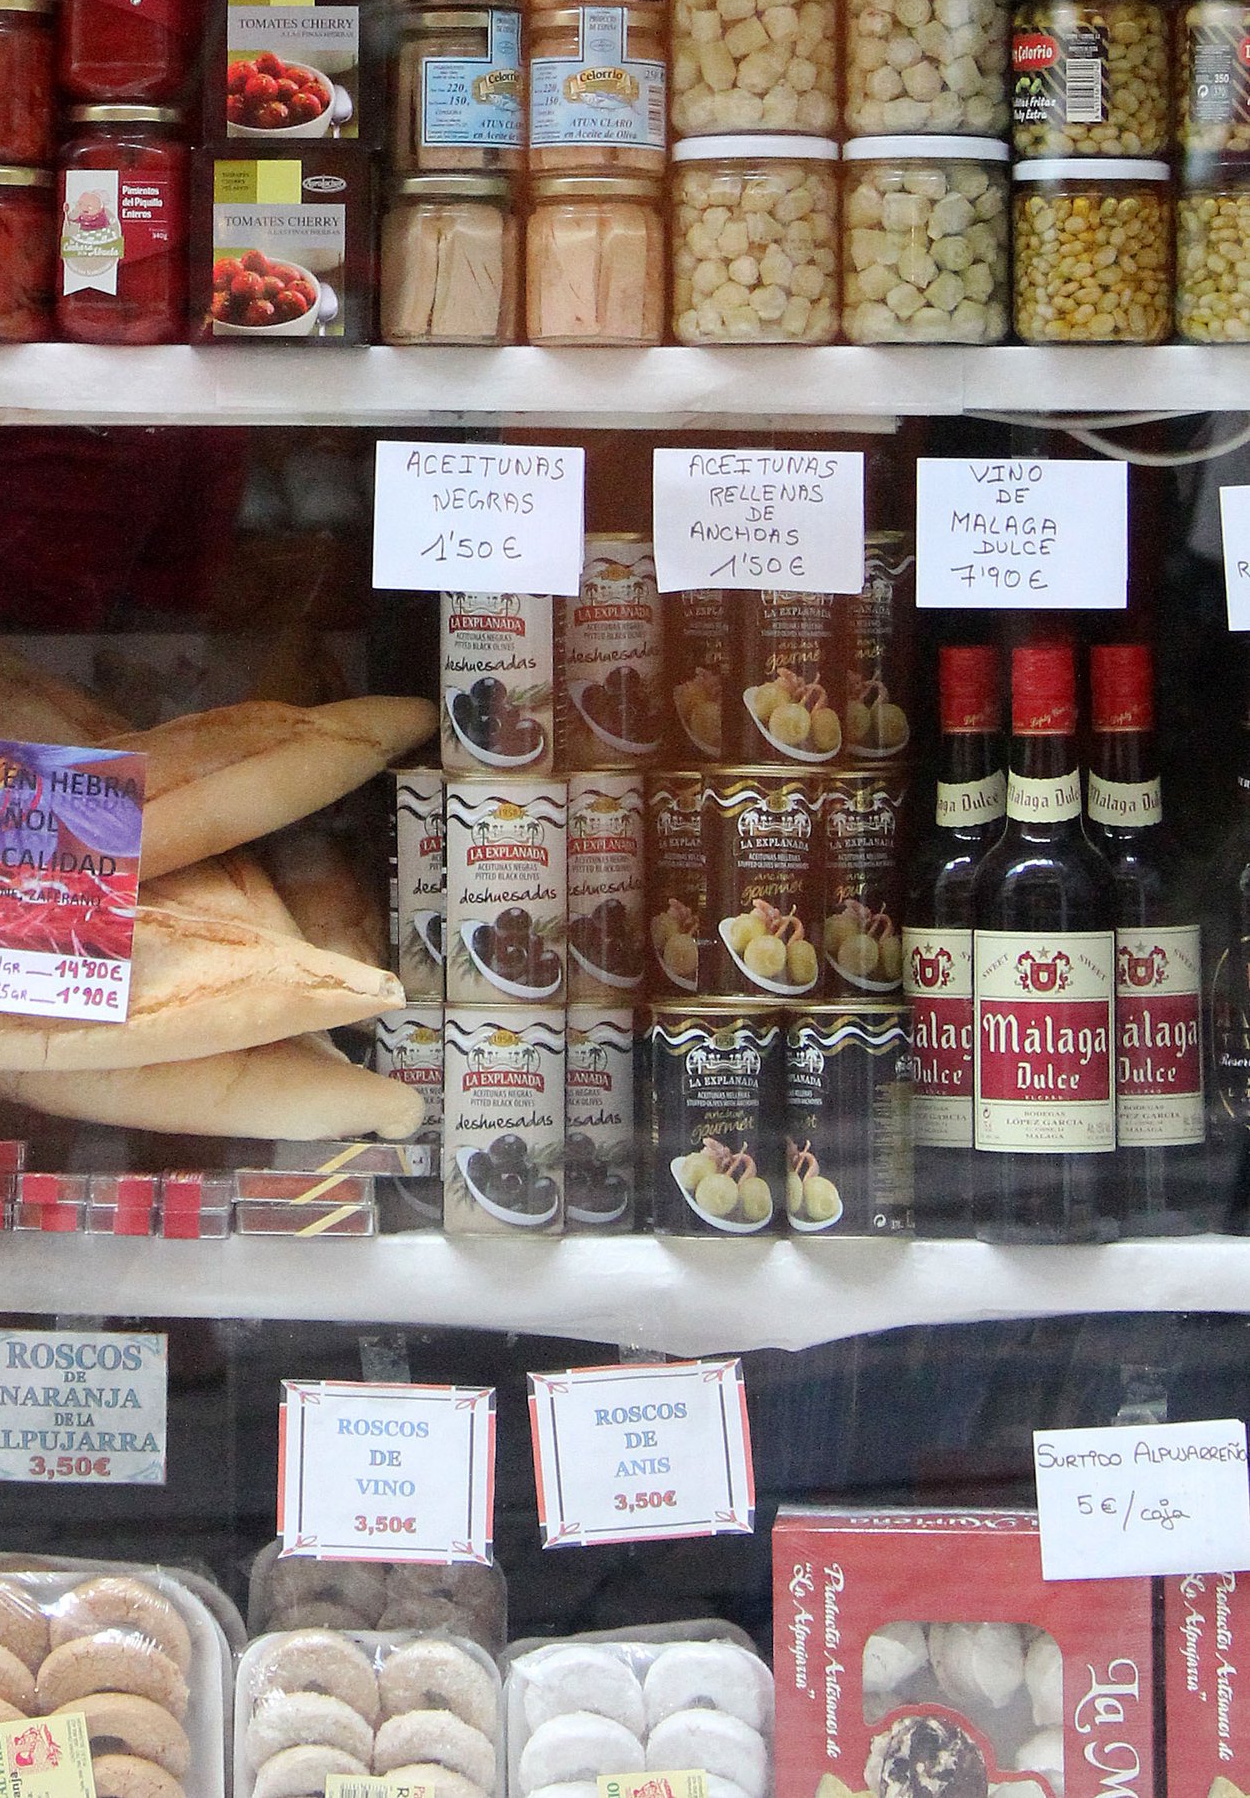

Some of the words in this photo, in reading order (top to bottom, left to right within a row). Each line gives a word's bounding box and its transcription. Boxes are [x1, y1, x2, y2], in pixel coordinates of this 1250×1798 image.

[238, 18, 299, 30] TOMATES
[301, 18, 354, 30] CHERRY
[579, 69, 623, 82] Celorrio
[1214, 74, 1229, 84] 350
[569, 118, 598, 128] ATUN
[600, 118, 633, 129] CLARO
[577, 129, 603, 139] Aceite
[617, 130, 638, 140] Oliva
[122, 186, 159, 196] Pimientos
[225, 216, 285, 227] TOMATES
[288, 216, 340, 227] CHERRY
[406, 450, 566, 480] ACEITUNAS
[688, 454, 839, 478] ACEITUNAS
[969, 464, 1043, 483] VINO
[433, 488, 534, 514] NEGRAS
[709, 484, 824, 504] RELLENAS
[951, 510, 1058, 535] MALAGA
[690, 522, 800, 546] ANCHOAS
[973, 538, 1055, 555] DULCE
[462, 618, 523, 635] EXPLANADA
[52, 771, 139, 796] HEBRA
[754, 836, 810, 852] EXPLANADA
[485, 846, 547, 863] EXPLANADA
[459, 887, 557, 904] deshuesadas
[981, 953, 1010, 979] SWEET
[481, 1073, 543, 1089] EXPLANADA
[704, 1075, 760, 1089] EXPLANADA
[1016, 1062, 1080, 1090] Dulce
[456, 1114, 554, 1131] deshuesadas
[6, 1342, 142, 1370] ROSCOS
[595, 1402, 687, 1427] ROSCOS
[337, 1418, 430, 1438] ROSCOS
[30, 1456, 111, 1479] 3,50€
[613, 1458, 671, 1478] ANIS
[356, 1478, 415, 1497] VINO
[614, 1490, 677, 1511] 3,50€
[354, 1515, 417, 1534] 3,50€
[823, 1562, 845, 1650] Productos
[824, 1651, 845, 1739] Artesanos
[1215, 1651, 1238, 1741] Artesanos
